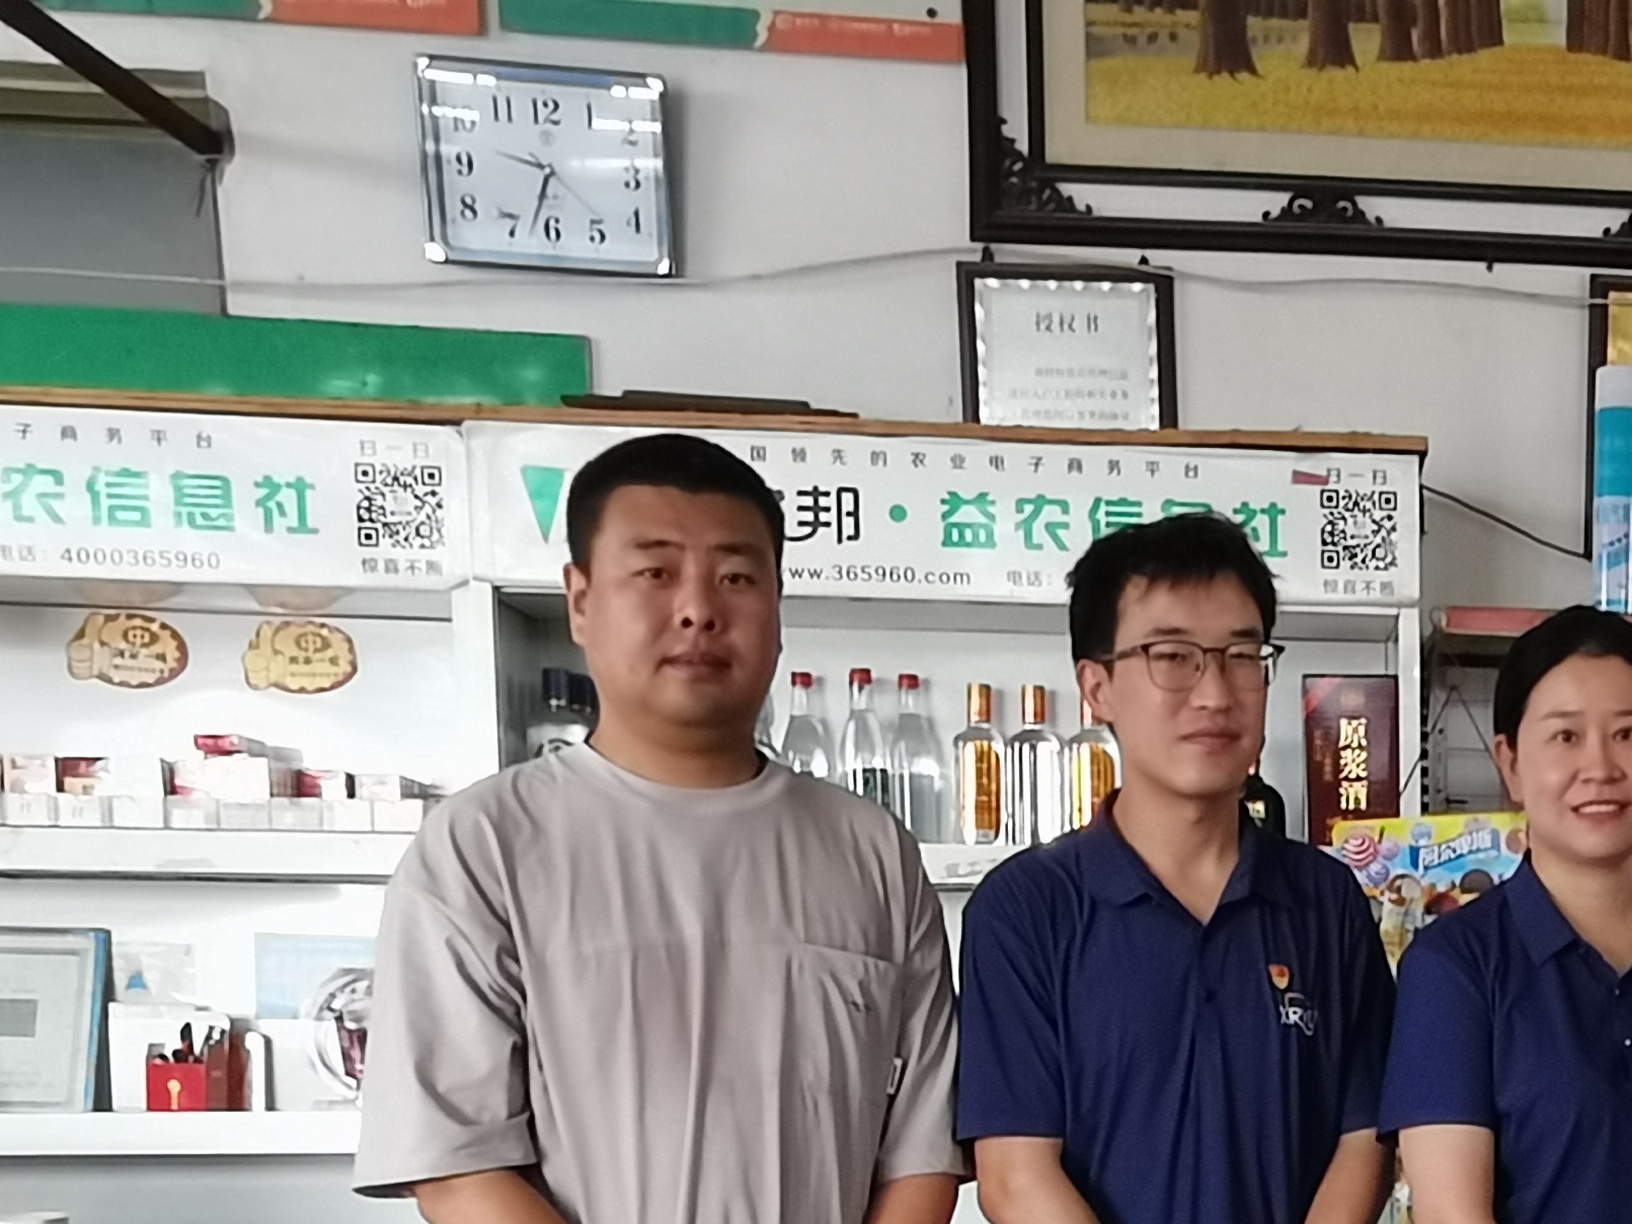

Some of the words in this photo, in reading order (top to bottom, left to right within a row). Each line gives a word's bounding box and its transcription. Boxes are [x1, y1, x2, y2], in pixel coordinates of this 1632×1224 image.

[492, 94, 513, 124] 11
[531, 97, 562, 127] 12
[585, 100, 594, 130] 1
[455, 150, 475, 177] 9
[623, 165, 642, 192] 3
[459, 193, 479, 222] 8
[626, 206, 642, 234] 4
[498, 206, 521, 239] 7
[543, 216, 562, 244] 6
[588, 218, 607, 246] 5
[0, 462, 320, 535] 农信息社
[60, 547, 221, 570] 4000365960
[1338, 717, 1368, 811] 原浆酒
